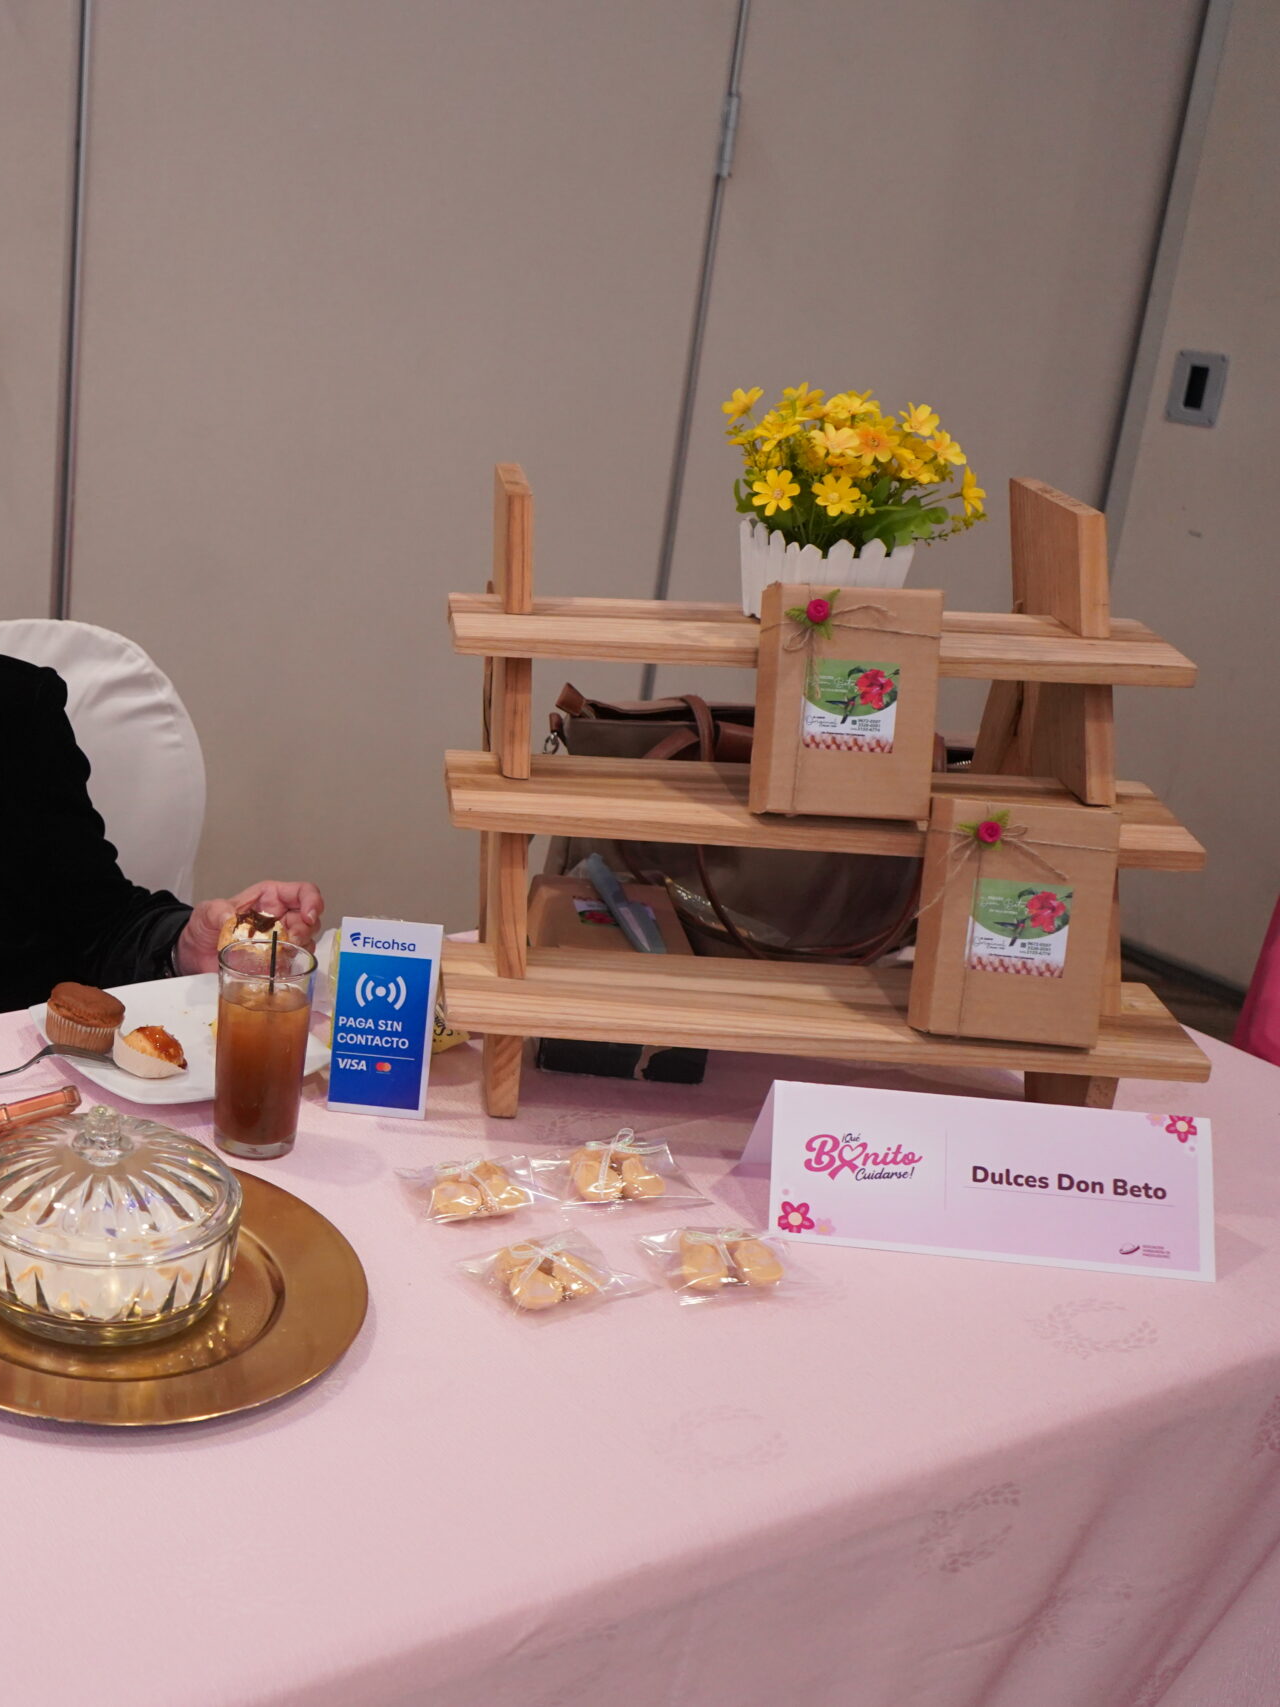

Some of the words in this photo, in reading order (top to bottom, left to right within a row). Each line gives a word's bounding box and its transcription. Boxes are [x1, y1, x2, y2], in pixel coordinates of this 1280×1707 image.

[362, 936, 417, 952] Ficohsa
[338, 1016, 375, 1030] PAGA
[378, 1019, 403, 1032] SIN
[337, 1032, 409, 1049] CONTACTO
[337, 1058, 367, 1071] VISA
[855, 1166, 915, 1181] Cuidarse!
[972, 1165, 1049, 1189] Dulces
[1057, 1173, 1104, 1194] Don
[1112, 1178, 1167, 1200] Beto
